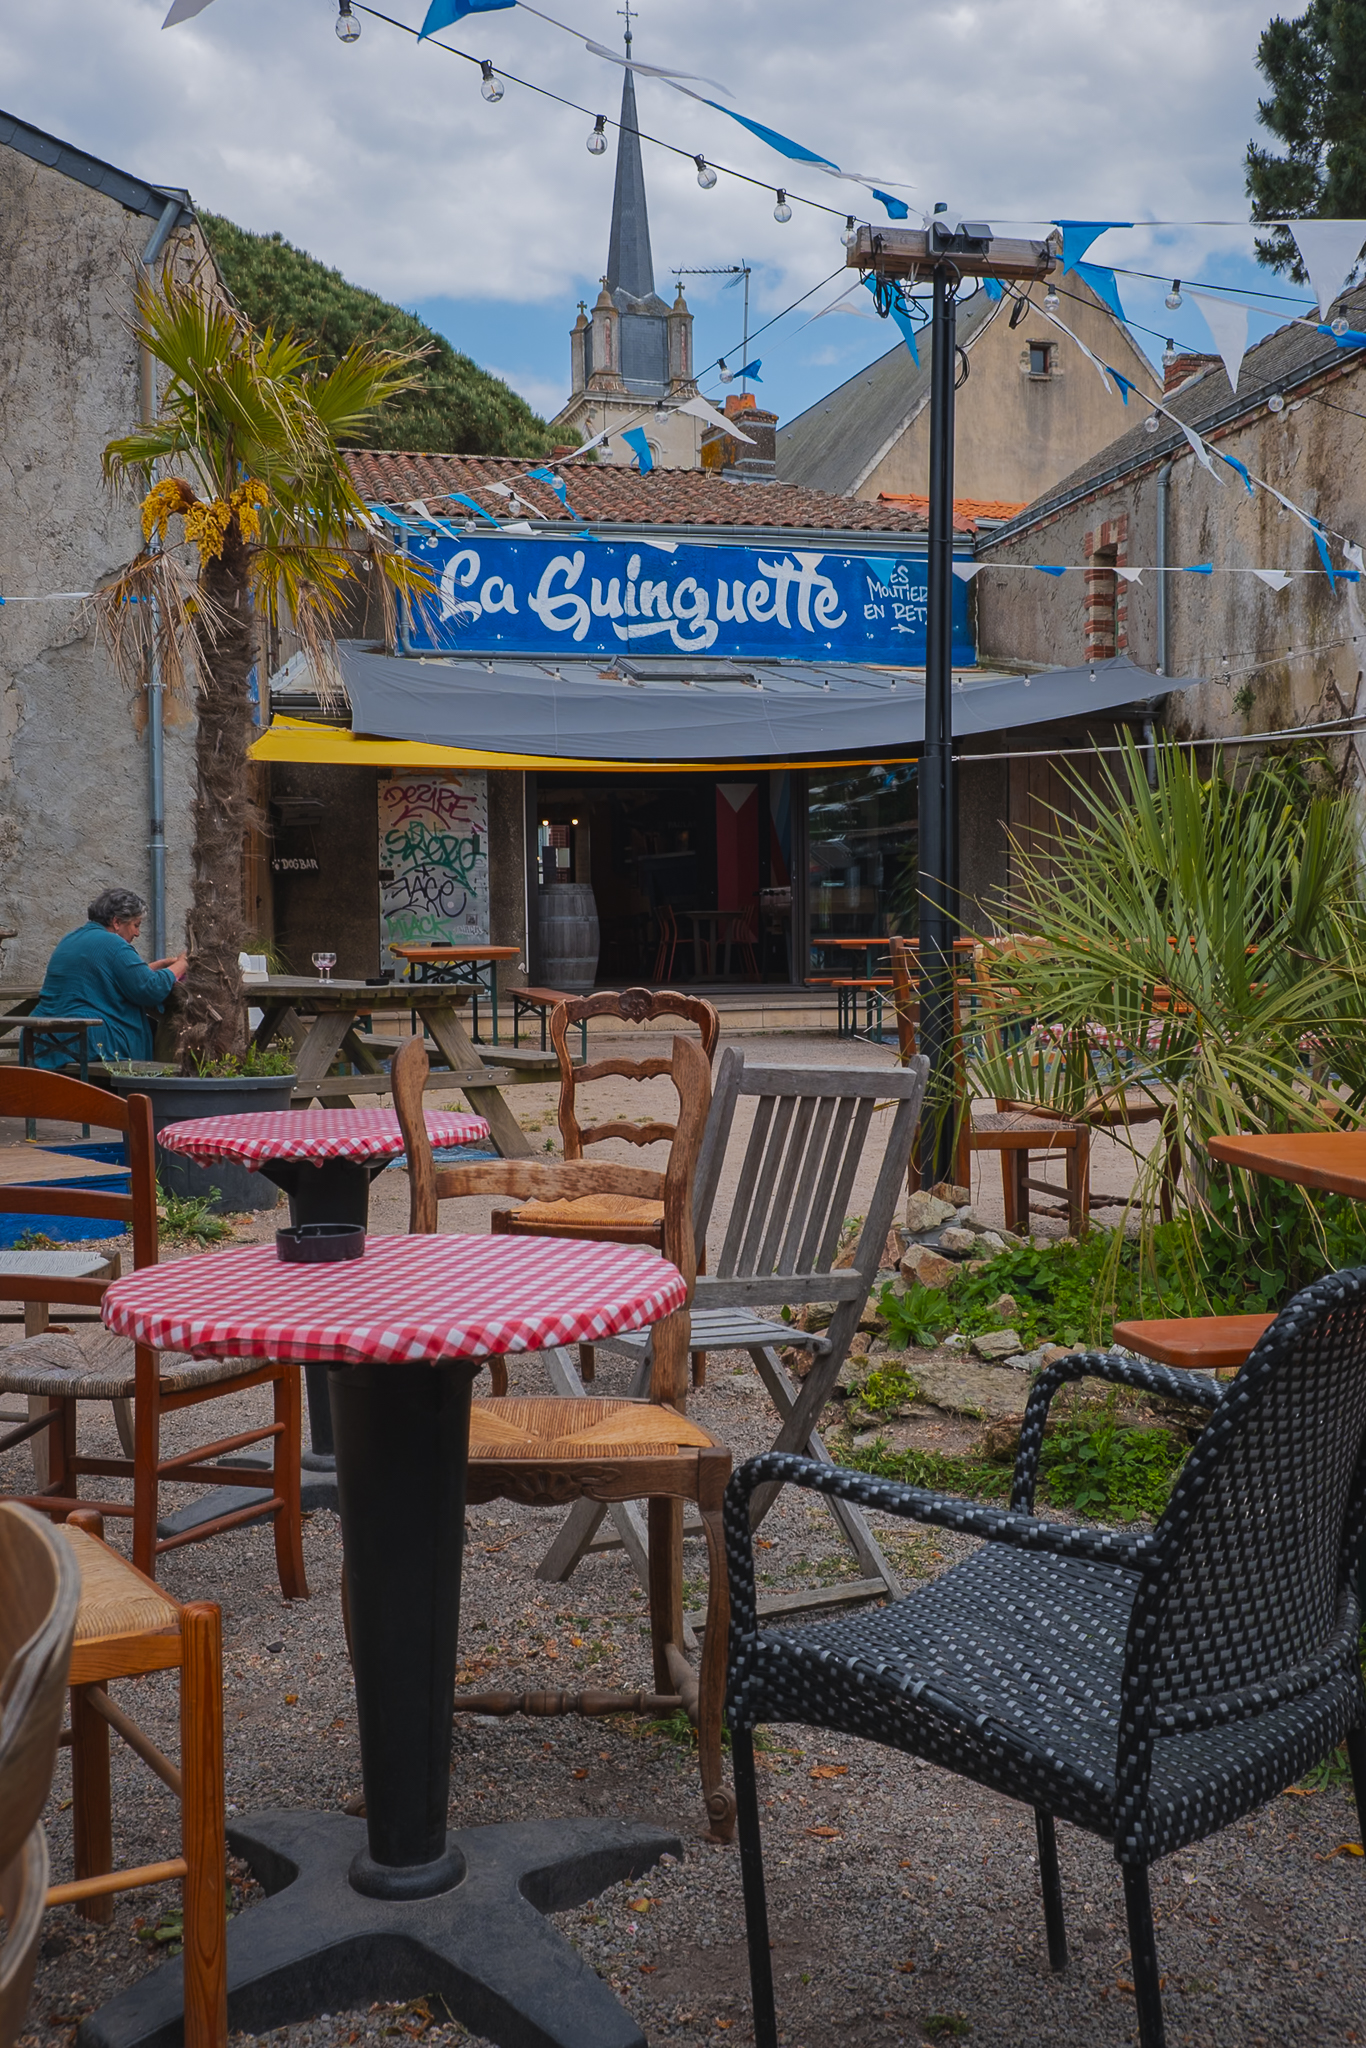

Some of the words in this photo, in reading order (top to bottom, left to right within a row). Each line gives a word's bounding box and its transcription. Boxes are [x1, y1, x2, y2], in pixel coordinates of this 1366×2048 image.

[439, 549, 519, 622] La
[528, 550, 847, 651] Guinguette
[864, 604, 885, 620] EN
[891, 603, 928, 624] RET
